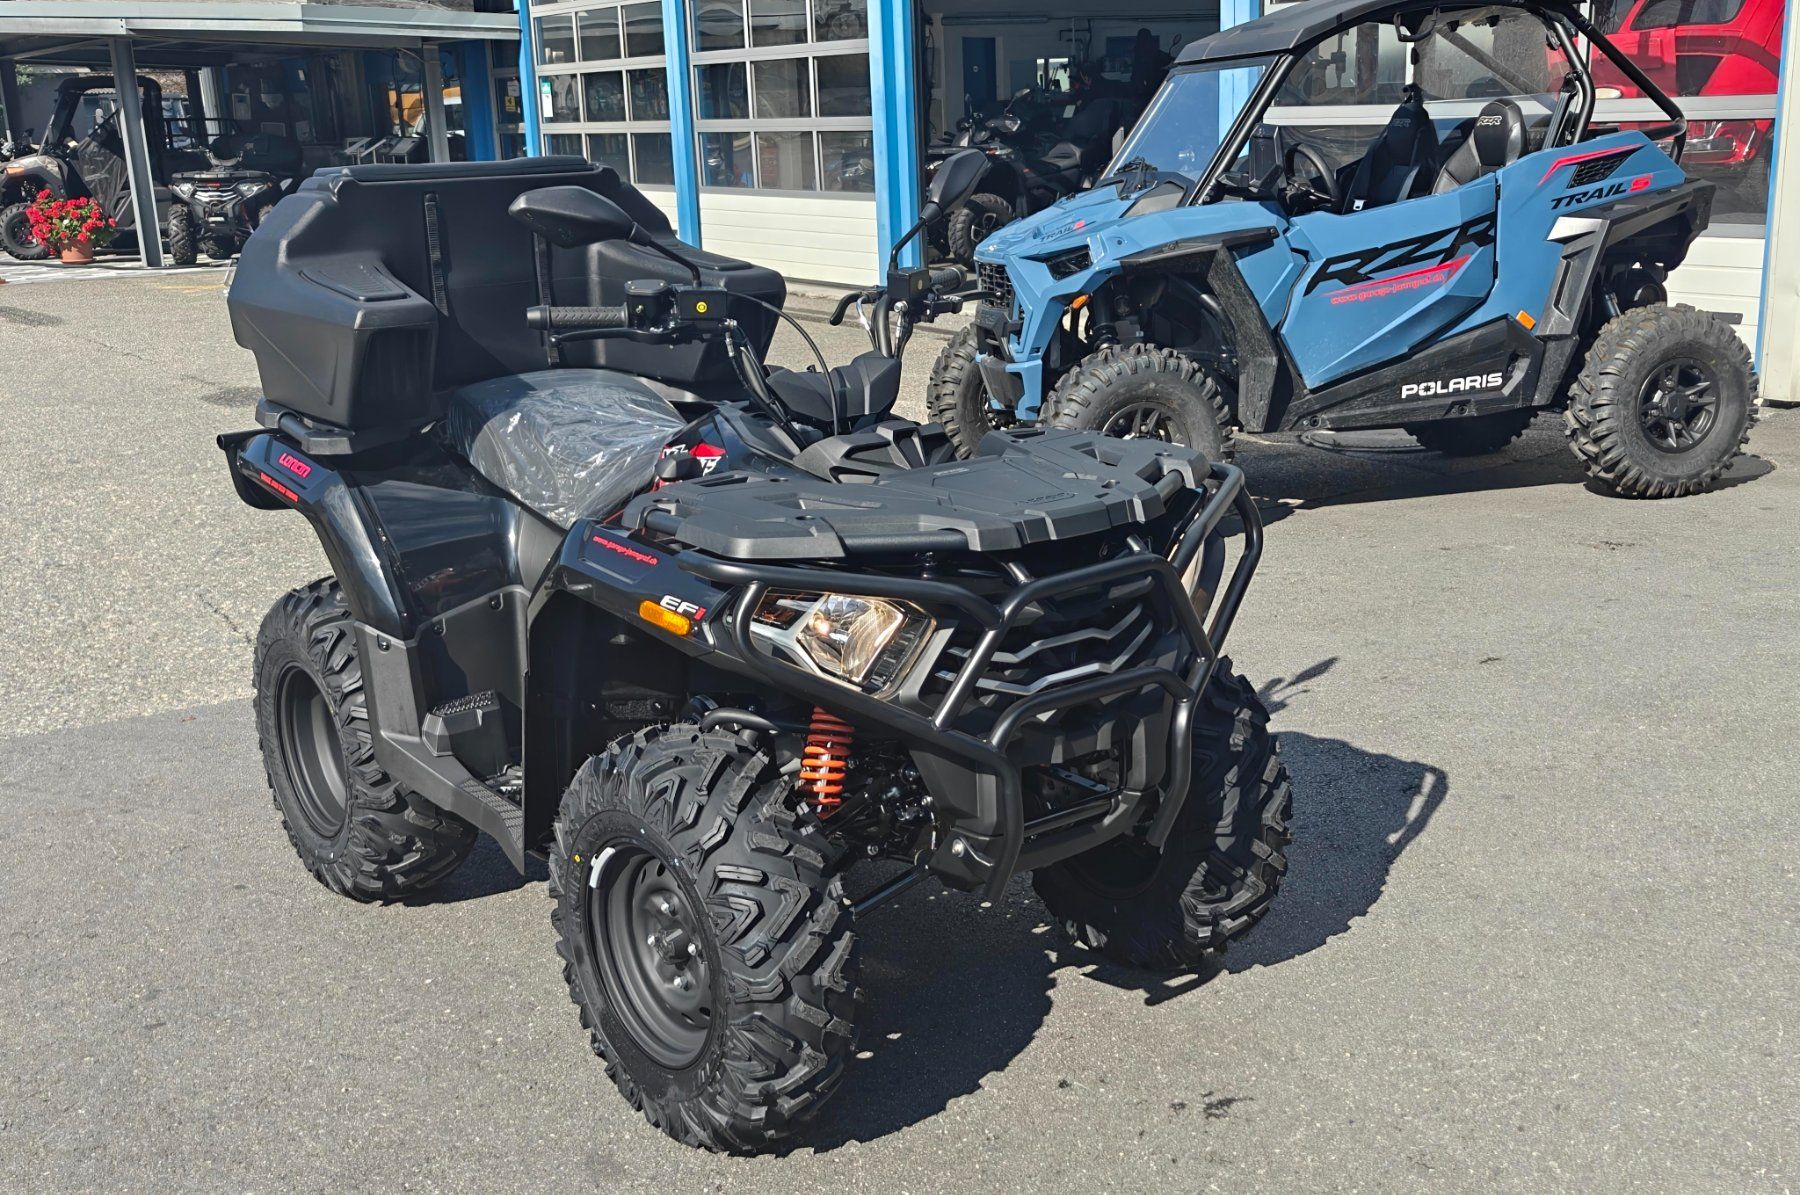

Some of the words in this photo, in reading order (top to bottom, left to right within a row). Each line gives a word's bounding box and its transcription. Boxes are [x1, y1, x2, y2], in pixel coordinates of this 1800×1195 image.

[1477, 116, 1502, 126] RZR
[1551, 183, 1627, 210] TRAIL
[1302, 211, 1495, 298] RZR
[1401, 372, 1503, 399] POLARIS
